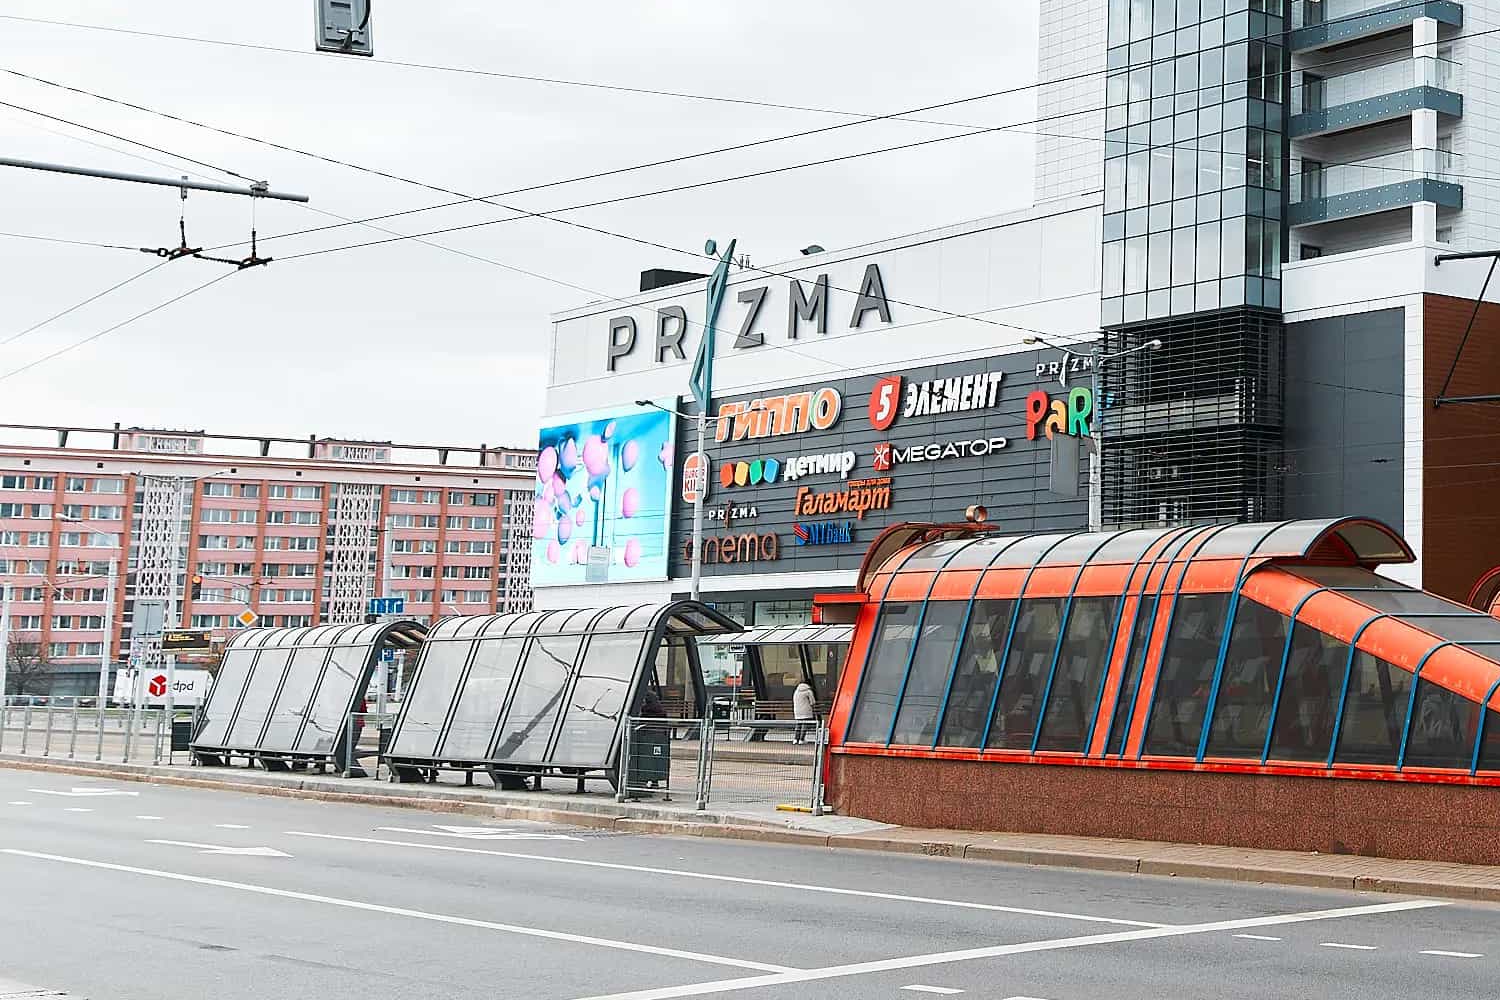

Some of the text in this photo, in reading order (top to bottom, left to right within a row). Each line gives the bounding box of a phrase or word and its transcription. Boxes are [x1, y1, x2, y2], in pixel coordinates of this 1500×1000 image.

[876, 371, 1003, 421] 5 ЭЛЕМЕНТ
[714, 387, 842, 443] ГИППО
[784, 451, 856, 481] детмир
[892, 437, 1007, 464] MEGATOP
[795, 486, 890, 520] Галамарт
[684, 532, 778, 563] cnema
[172, 680, 194, 692] dpd
